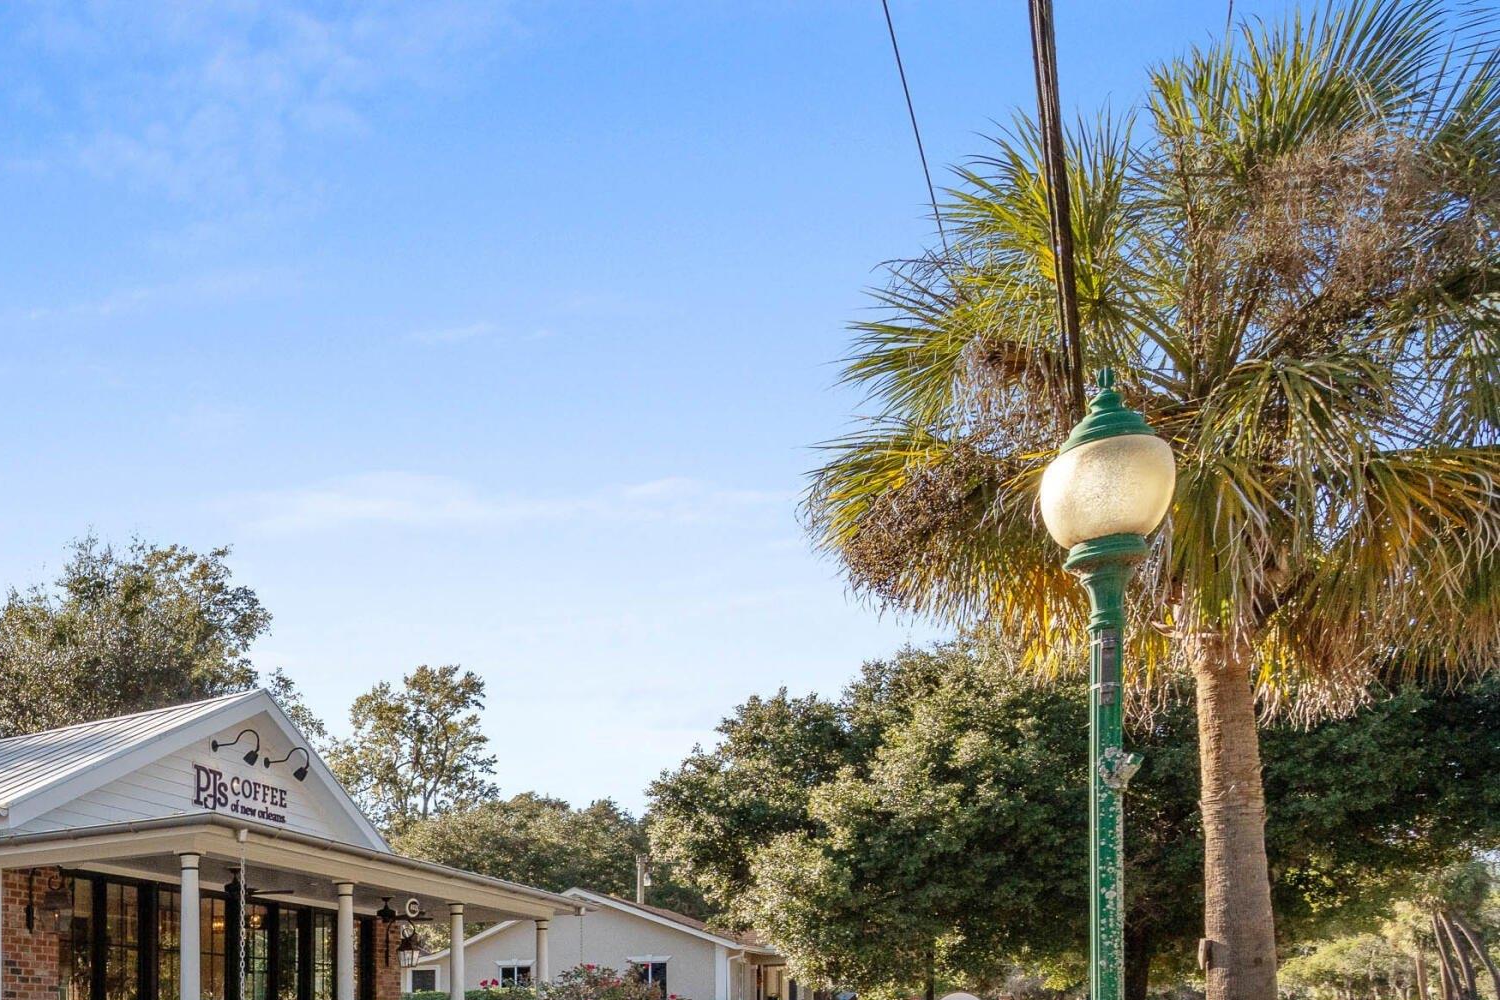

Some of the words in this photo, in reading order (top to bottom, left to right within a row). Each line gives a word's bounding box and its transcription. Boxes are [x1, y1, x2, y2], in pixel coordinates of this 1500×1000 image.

[230, 776, 287, 808] COFFEE
[230, 800, 240, 813] of
[240, 805, 257, 817] new
[257, 806, 286, 823] orleans
